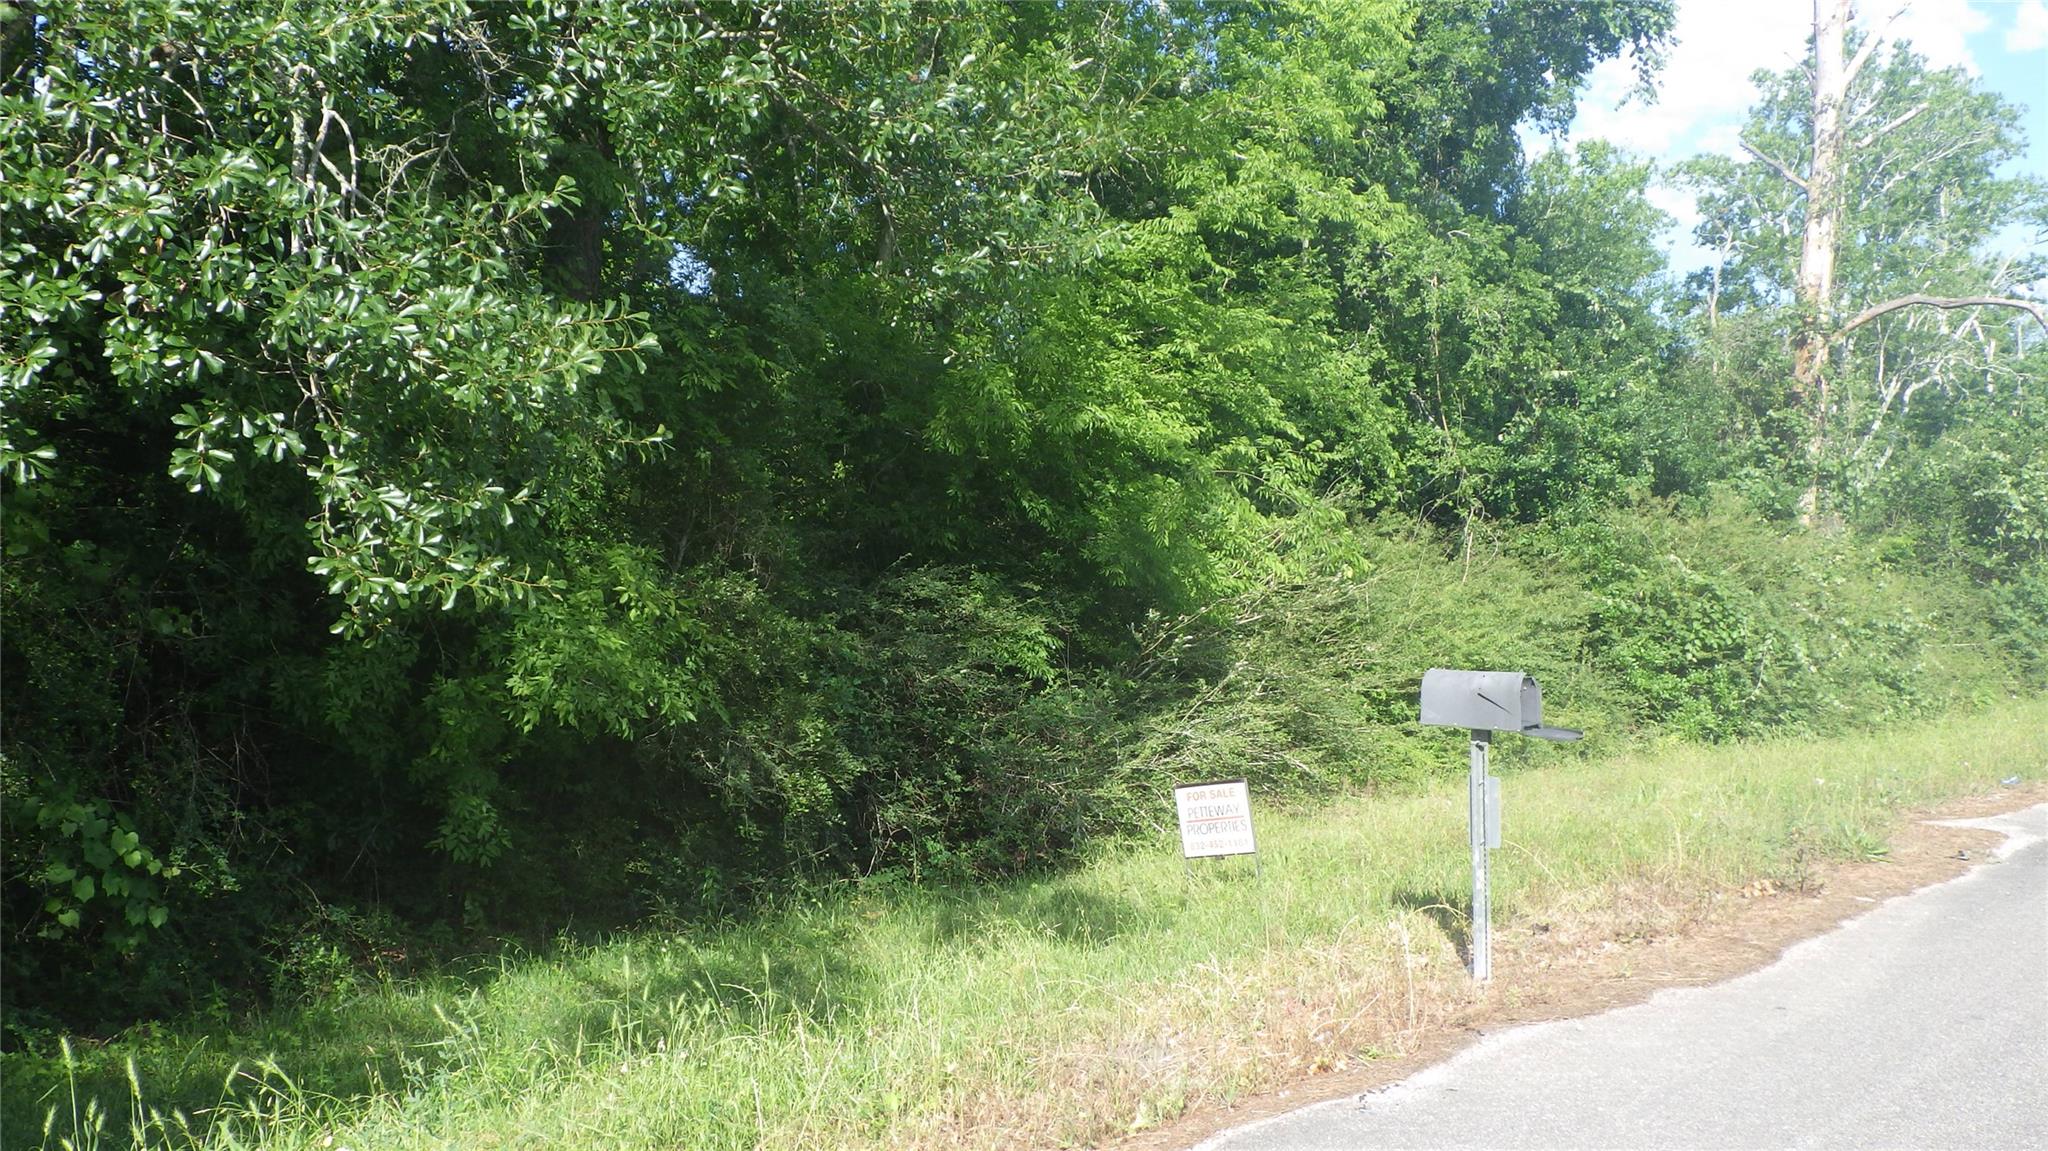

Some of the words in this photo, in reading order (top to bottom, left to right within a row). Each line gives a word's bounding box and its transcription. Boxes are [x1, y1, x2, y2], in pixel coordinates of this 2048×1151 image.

[1186, 790, 1207, 802] FOR
[1209, 787, 1236, 800] SALE
[1187, 803, 1240, 819] PETTEWAY
[1186, 819, 1248, 836] PROPERTIES
